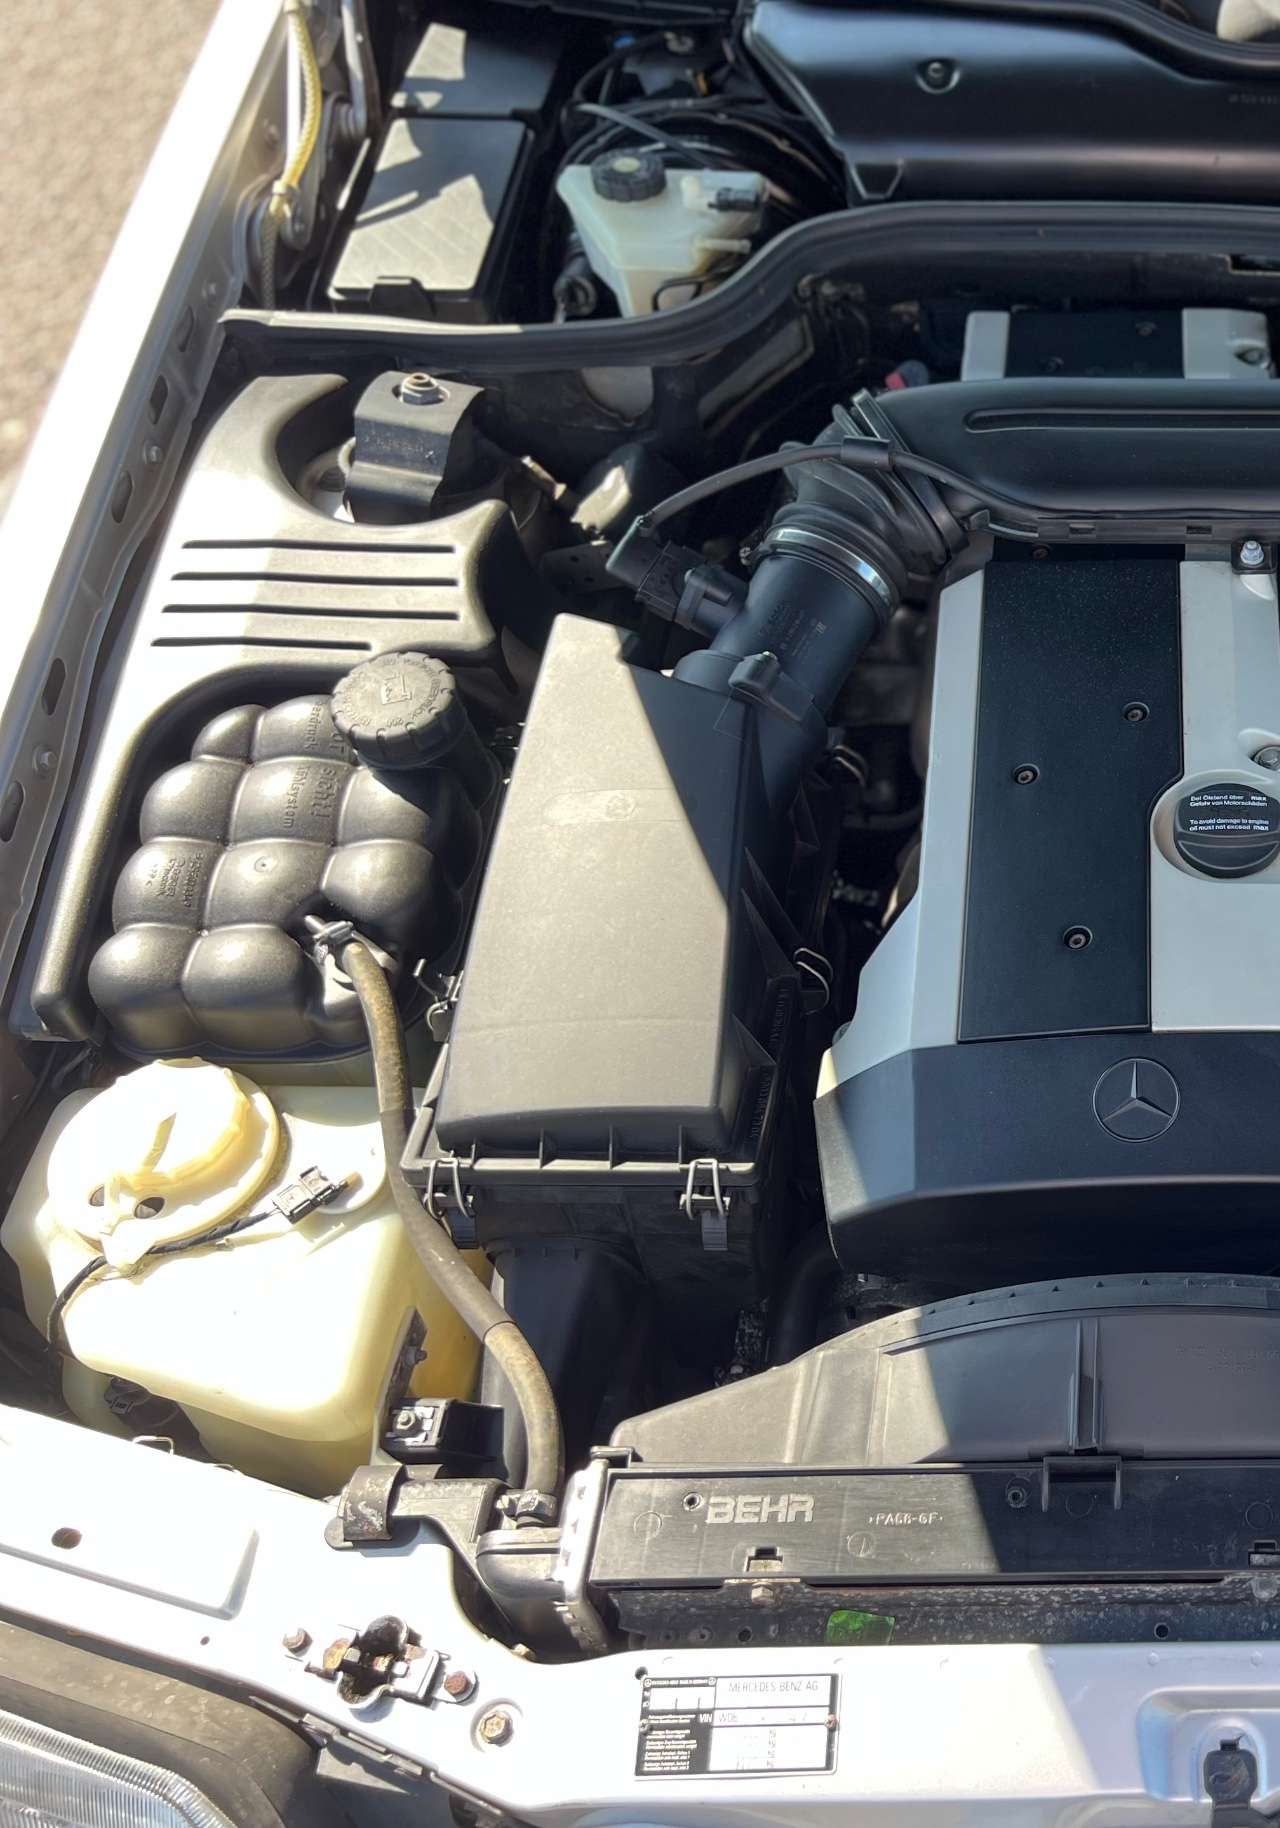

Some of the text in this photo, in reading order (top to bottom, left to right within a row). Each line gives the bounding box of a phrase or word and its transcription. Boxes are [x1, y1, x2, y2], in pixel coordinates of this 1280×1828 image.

[706, 1494, 816, 1524] BEHR
[805, 1679, 819, 1692] AG
[699, 1713, 713, 1723] VIN
